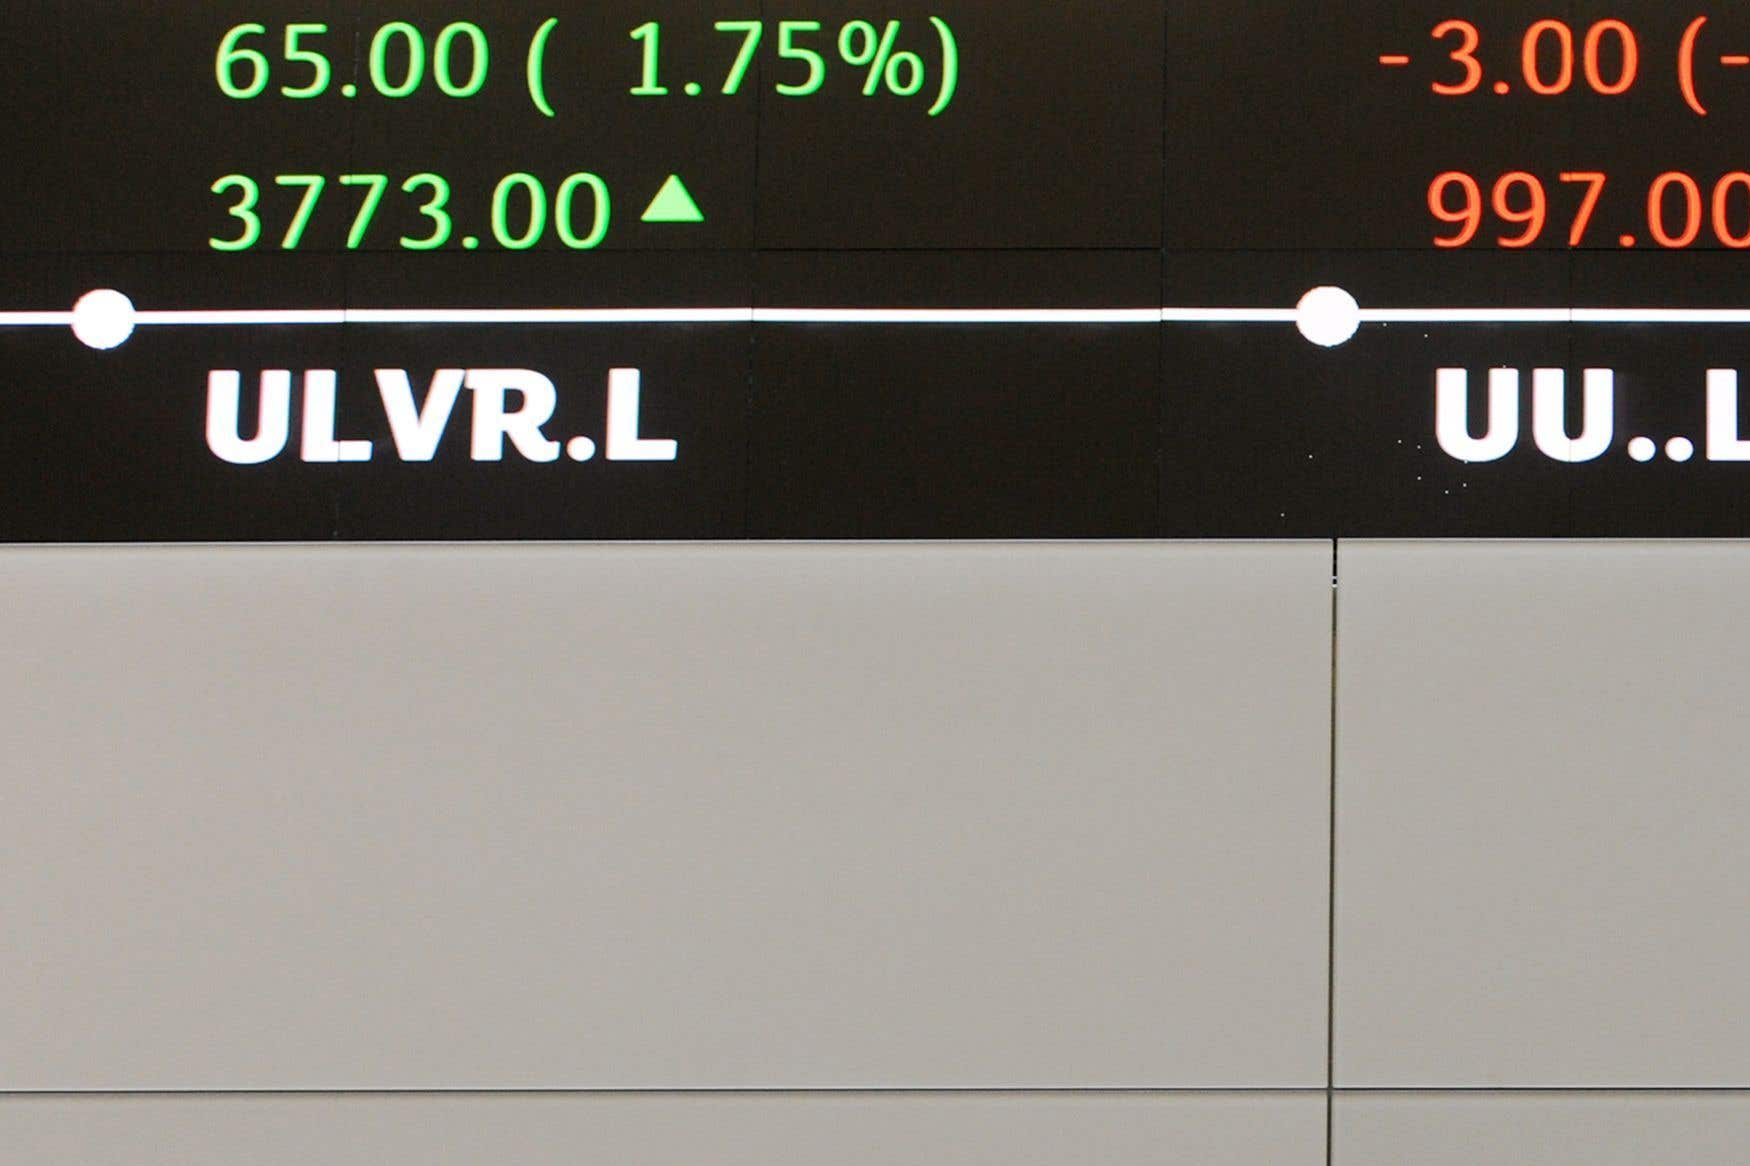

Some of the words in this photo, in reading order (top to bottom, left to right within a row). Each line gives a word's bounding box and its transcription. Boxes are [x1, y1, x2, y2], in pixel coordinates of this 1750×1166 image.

[214, 22, 491, 100] 65.00
[1378, 18, 1640, 97] -3.00
[208, 172, 612, 252] 3773.00
[204, 367, 678, 465] ULVR.L
